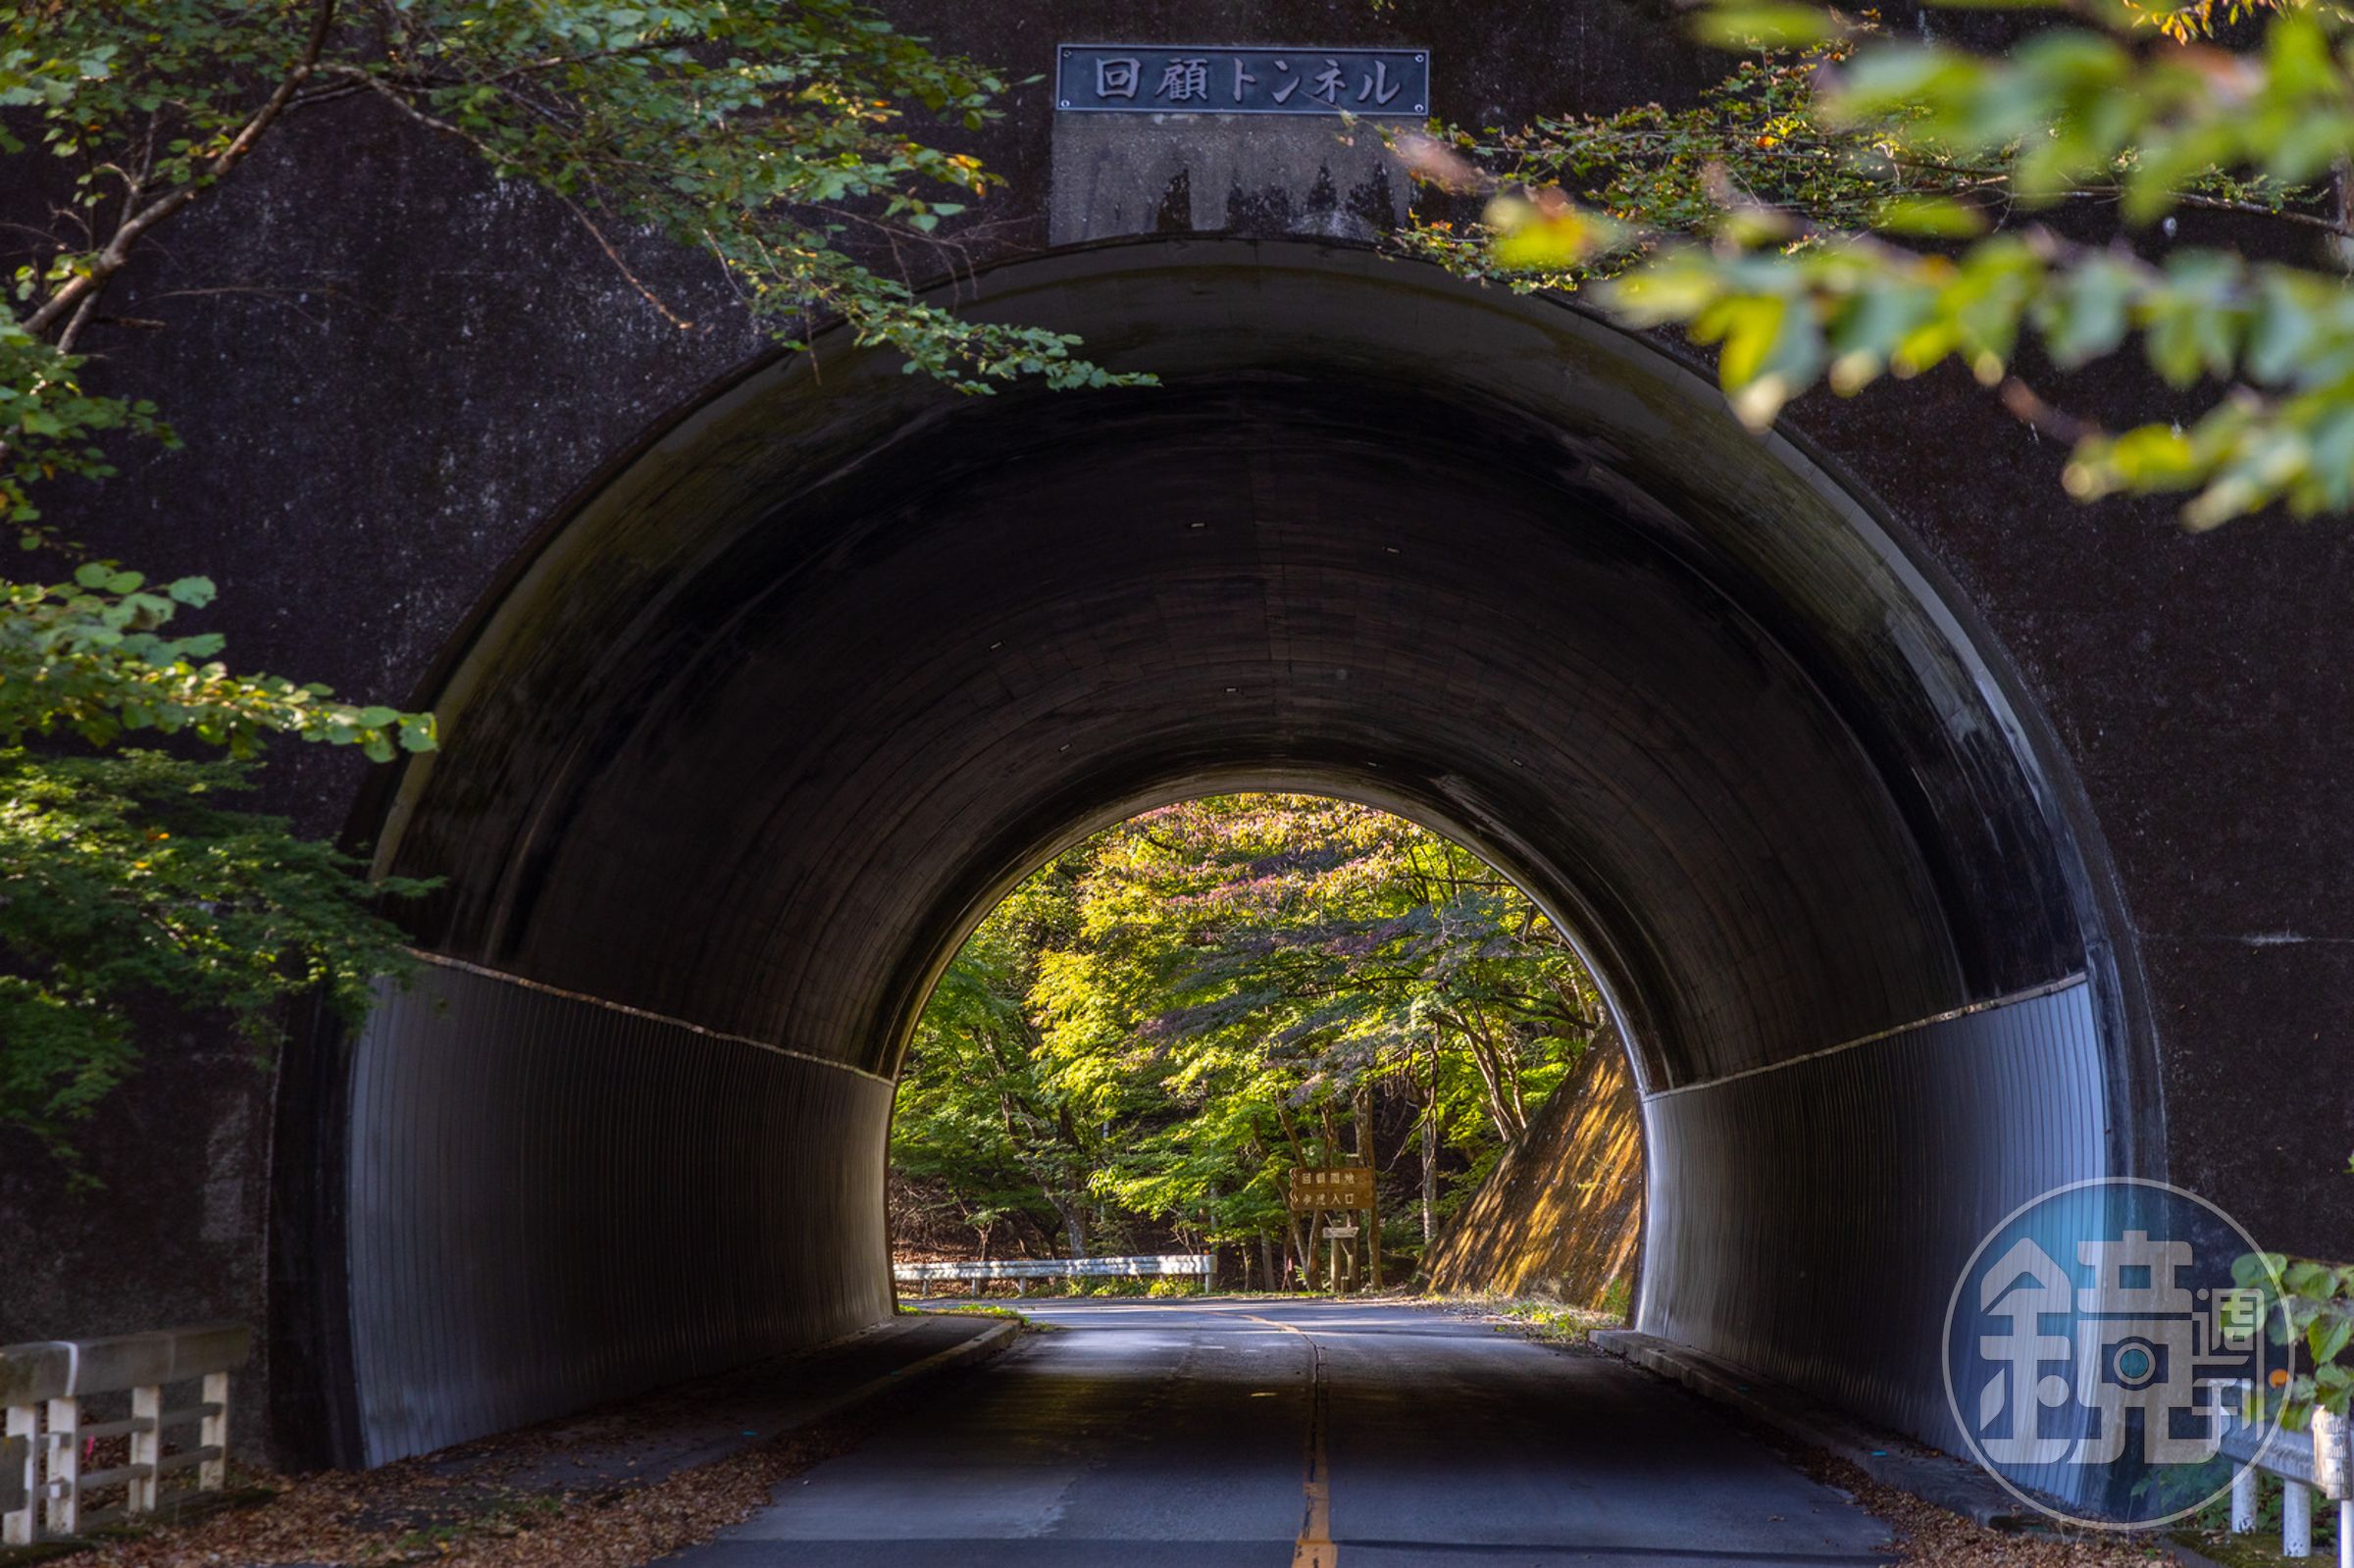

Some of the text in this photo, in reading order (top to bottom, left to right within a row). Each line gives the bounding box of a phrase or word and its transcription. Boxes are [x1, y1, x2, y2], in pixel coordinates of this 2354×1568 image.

[1095, 56, 1401, 105] 回顧トンネル
